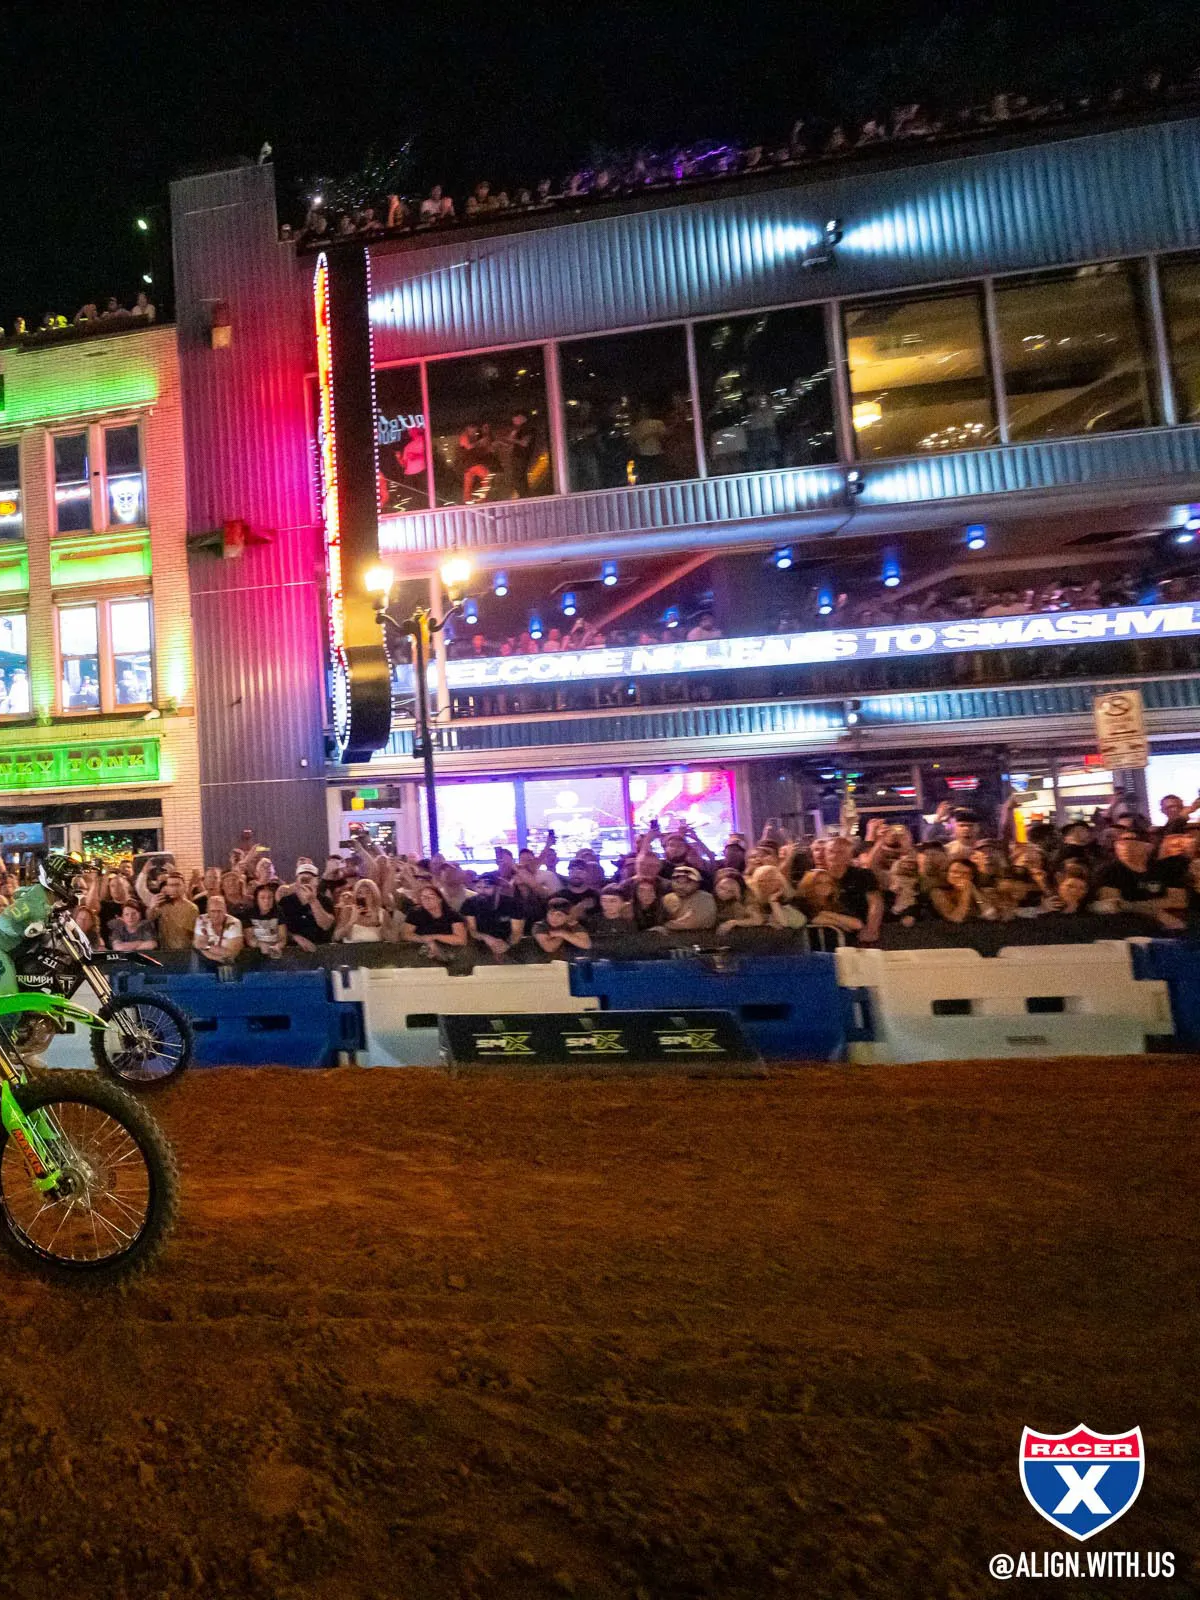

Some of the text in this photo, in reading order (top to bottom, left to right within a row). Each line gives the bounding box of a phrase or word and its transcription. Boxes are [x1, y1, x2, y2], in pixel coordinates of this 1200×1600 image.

[428, 650, 625, 686] ELCOME
[866, 627, 936, 654] TO
[69, 753, 145, 772] TONK
[475, 1034, 532, 1051] SMX
[565, 1033, 624, 1050] SMX
[658, 1032, 722, 1049] SMX
